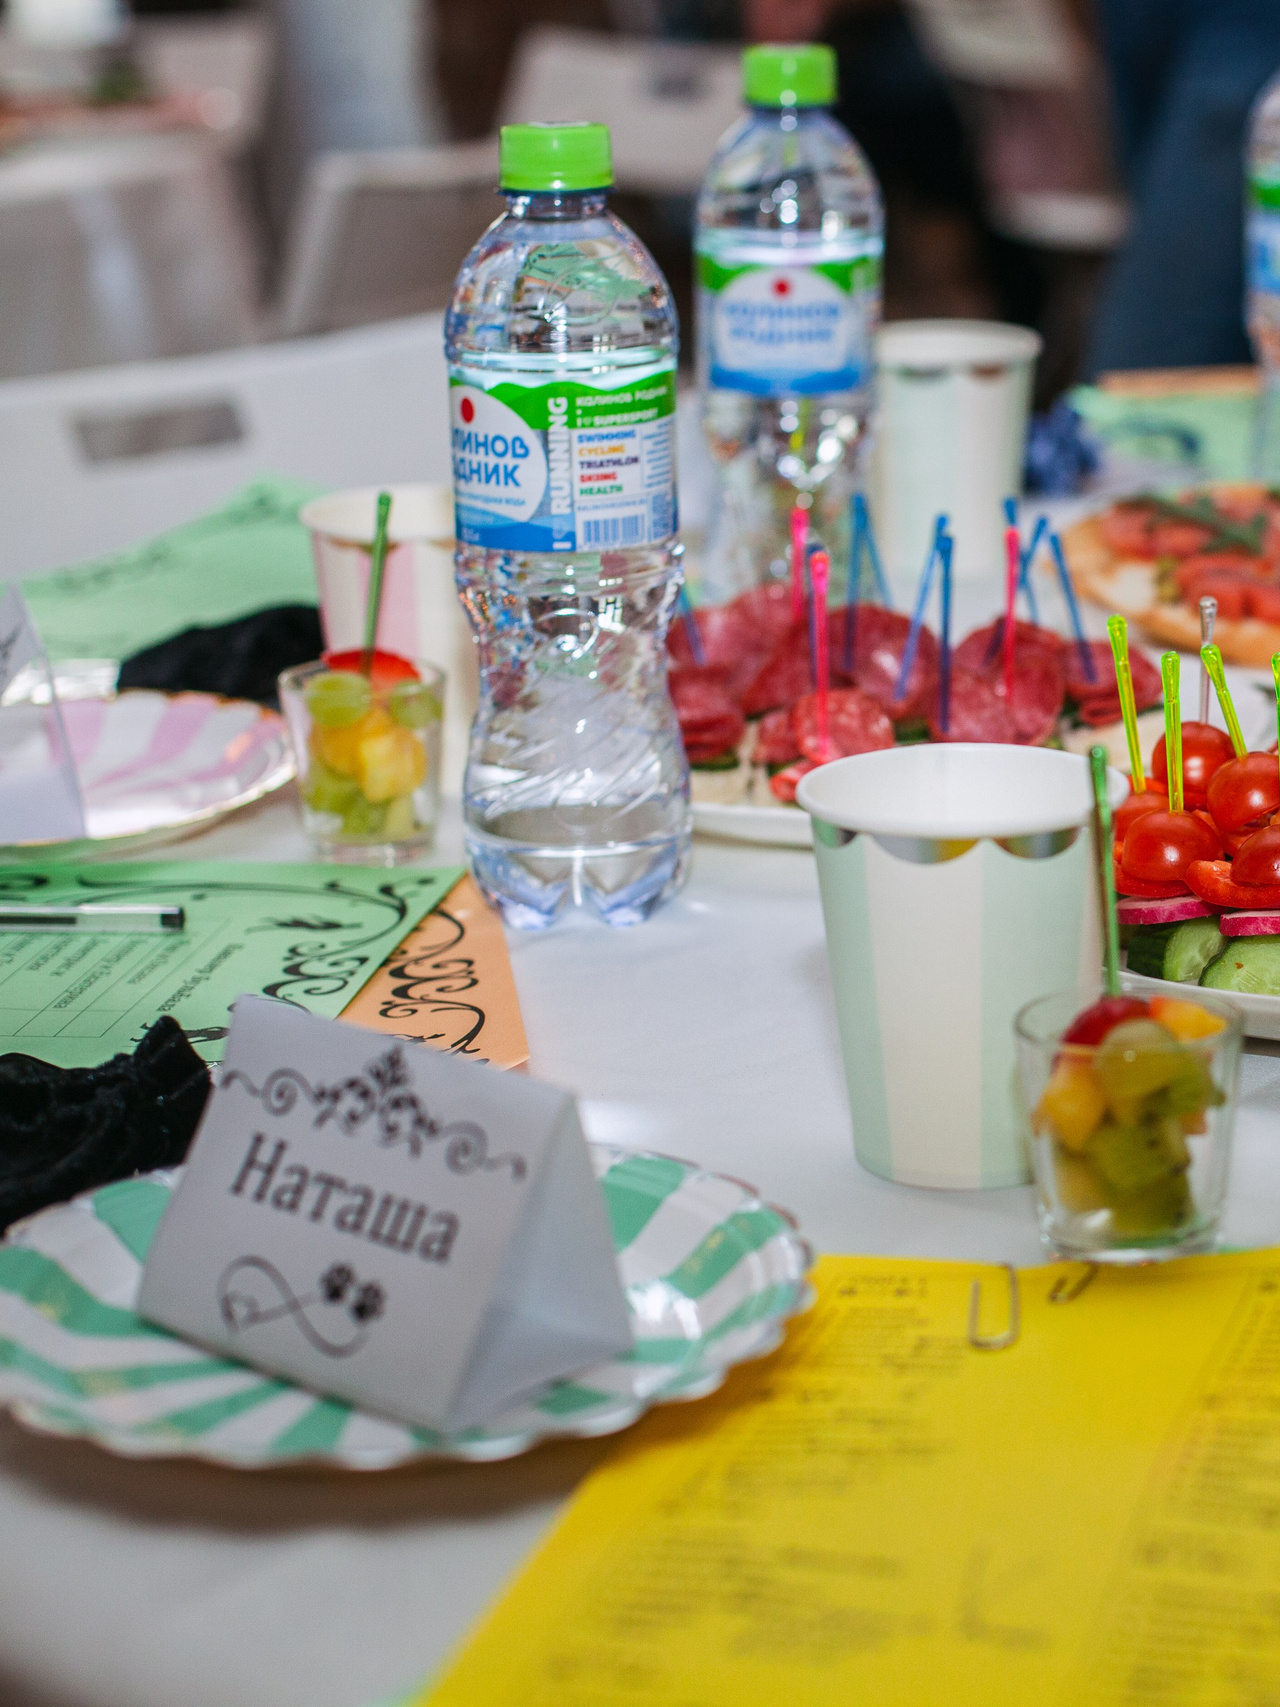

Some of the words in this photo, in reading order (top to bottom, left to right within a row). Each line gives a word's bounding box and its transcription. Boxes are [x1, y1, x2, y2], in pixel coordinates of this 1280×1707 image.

[453, 427, 530, 459] ЛИНОВ
[577, 429, 636, 444] SWIMMING
[548, 397, 573, 516] RUNNING
[578, 444, 626, 457] CYCLING
[454, 457, 521, 488] ДНИК
[579, 456, 640, 470] TRIATHLON
[579, 484, 623, 497] HEALTH
[230, 1130, 460, 1264] Наташа
